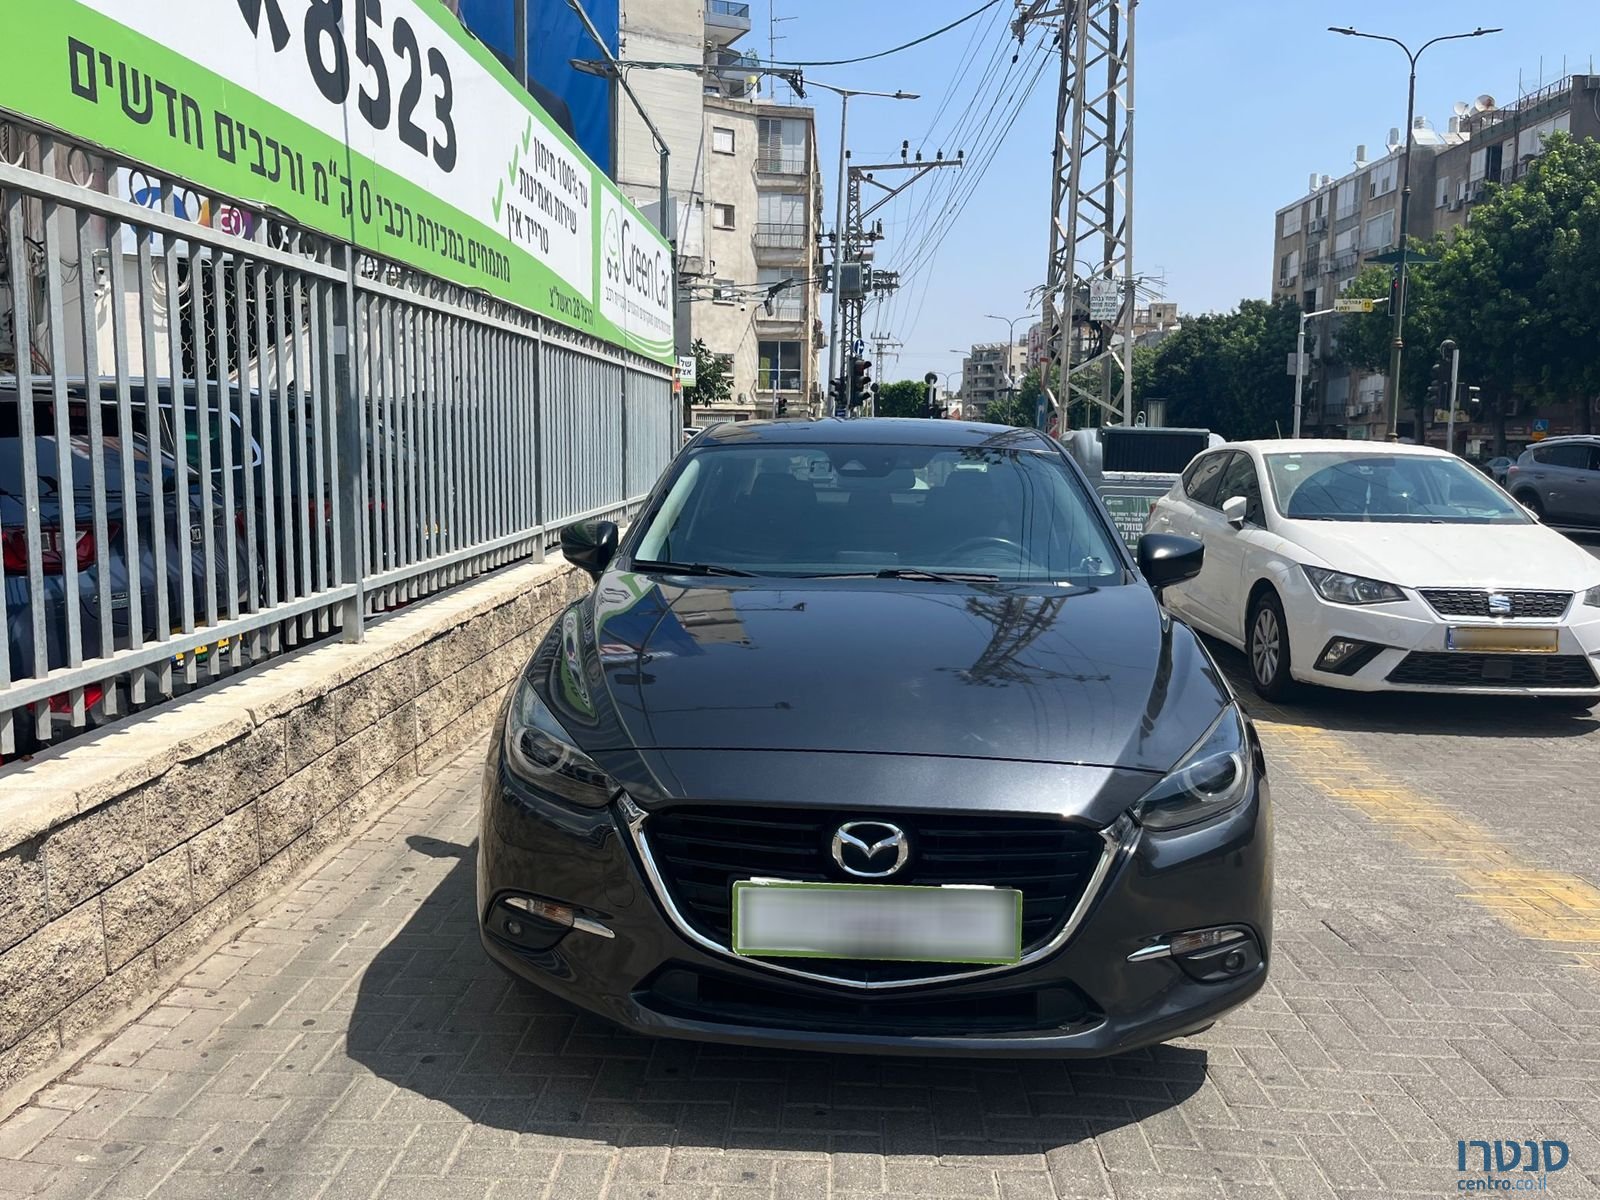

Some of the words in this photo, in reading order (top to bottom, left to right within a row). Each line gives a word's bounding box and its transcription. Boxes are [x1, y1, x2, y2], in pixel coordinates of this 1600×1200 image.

[68, 35, 204, 151] חדשים
[214, 110, 305, 195] ורכבים
[534, 136, 556, 180] מימון
[519, 167, 553, 217] ואמינות
[557, 156, 578, 200] 100%
[579, 180, 588, 209] עד
[360, 178, 372, 225] 0
[376, 194, 414, 242] רכבי
[507, 202, 522, 242] אין
[554, 196, 577, 235] שירות
[417, 213, 465, 265] במכירת
[525, 214, 549, 255] טרייד
[468, 238, 510, 283] מתמחים
[621, 219, 654, 303] Green
[655, 250, 670, 312] Car
